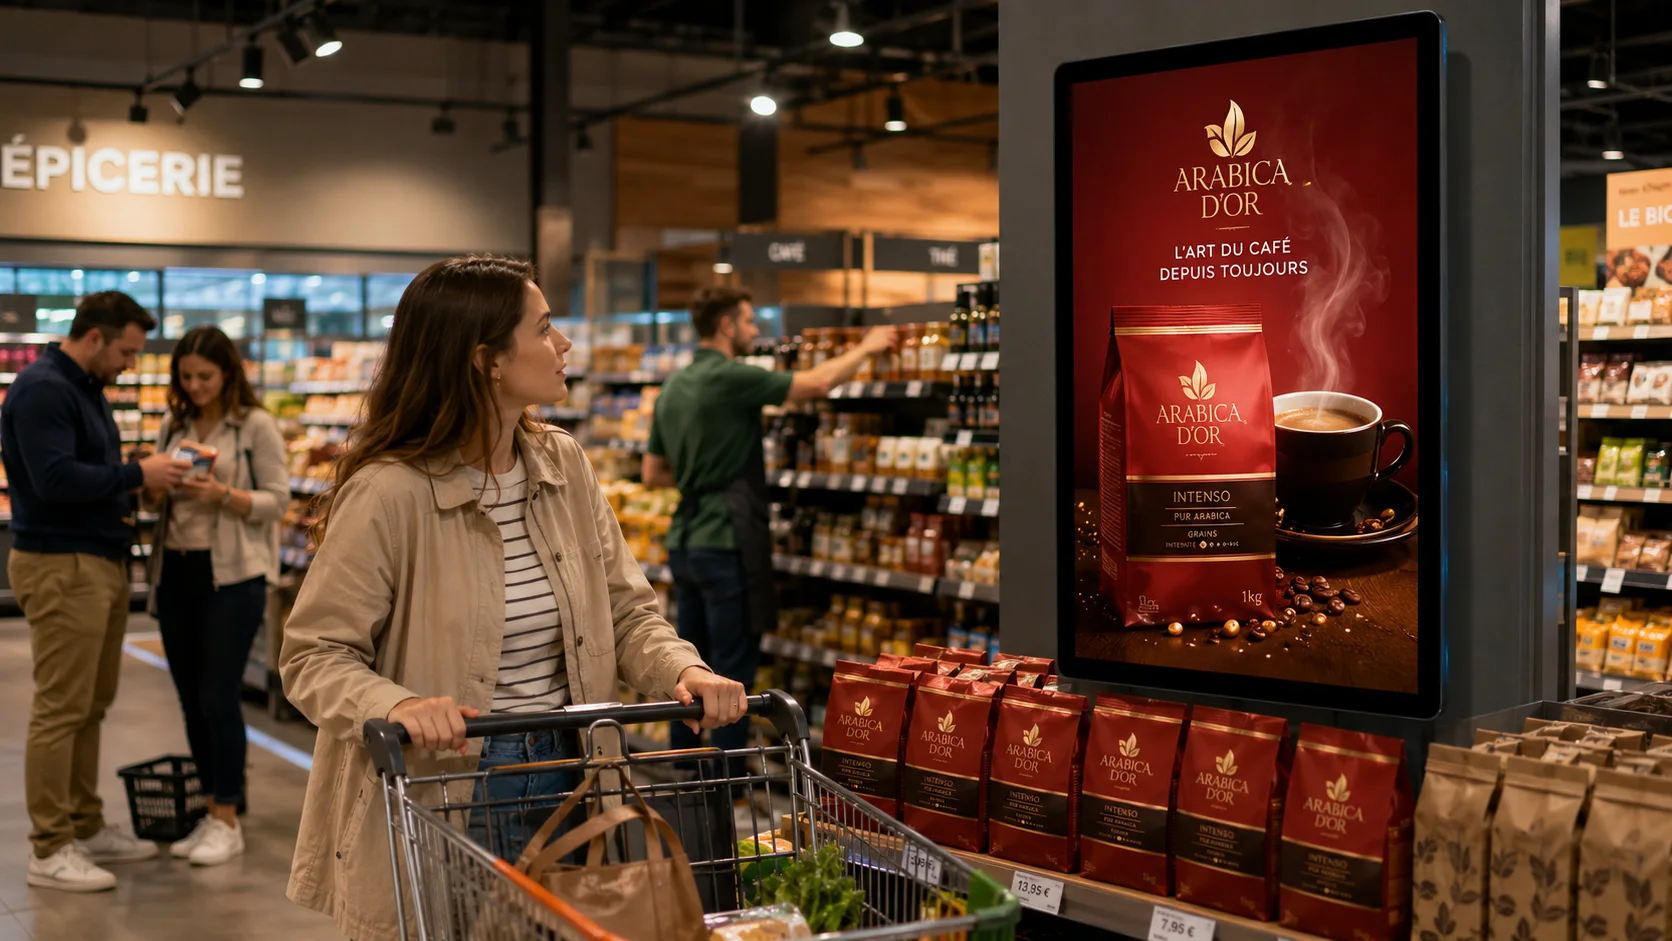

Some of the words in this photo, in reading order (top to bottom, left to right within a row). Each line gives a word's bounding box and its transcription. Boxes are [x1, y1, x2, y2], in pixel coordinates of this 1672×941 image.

[1, 133, 245, 198] ÉPICERIE
[1173, 158, 1293, 193] ARABICA
[1201, 191, 1264, 219] D'OR
[1618, 207, 1641, 228] LE
[1174, 244, 1216, 260] L'ART
[1221, 242, 1243, 257] DU
[1249, 236, 1291, 255] CAFÉ
[1159, 265, 1215, 281] DEPUIS
[1220, 260, 1309, 278] TOUJOURS
[1156, 403, 1245, 424] ARABICA
[1176, 425, 1225, 446] D'OR
[1173, 489, 1231, 503] INTENSO
[1173, 512, 1191, 521] PUR
[1193, 511, 1231, 520] ARABICA
[1187, 529, 1218, 538] GRAINS
[1242, 590, 1263, 606] 1kg
[837, 714, 883, 732] ARABICA
[920, 730, 965, 749] ARABICA
[1006, 743, 1052, 763] ARABICA
[1100, 754, 1153, 776] ARABICA
[1195, 772, 1249, 795] ARABICA
[1104, 804, 1139, 818] INTENSO
[1303, 796, 1364, 823] ARABICA
[1200, 824, 1235, 840] INTENSO
[1308, 852, 1348, 869] INTENSO
[1044, 887, 1051, 898] €
[1161, 918, 1185, 935] 7,95
[1187, 926, 1196, 938] €
